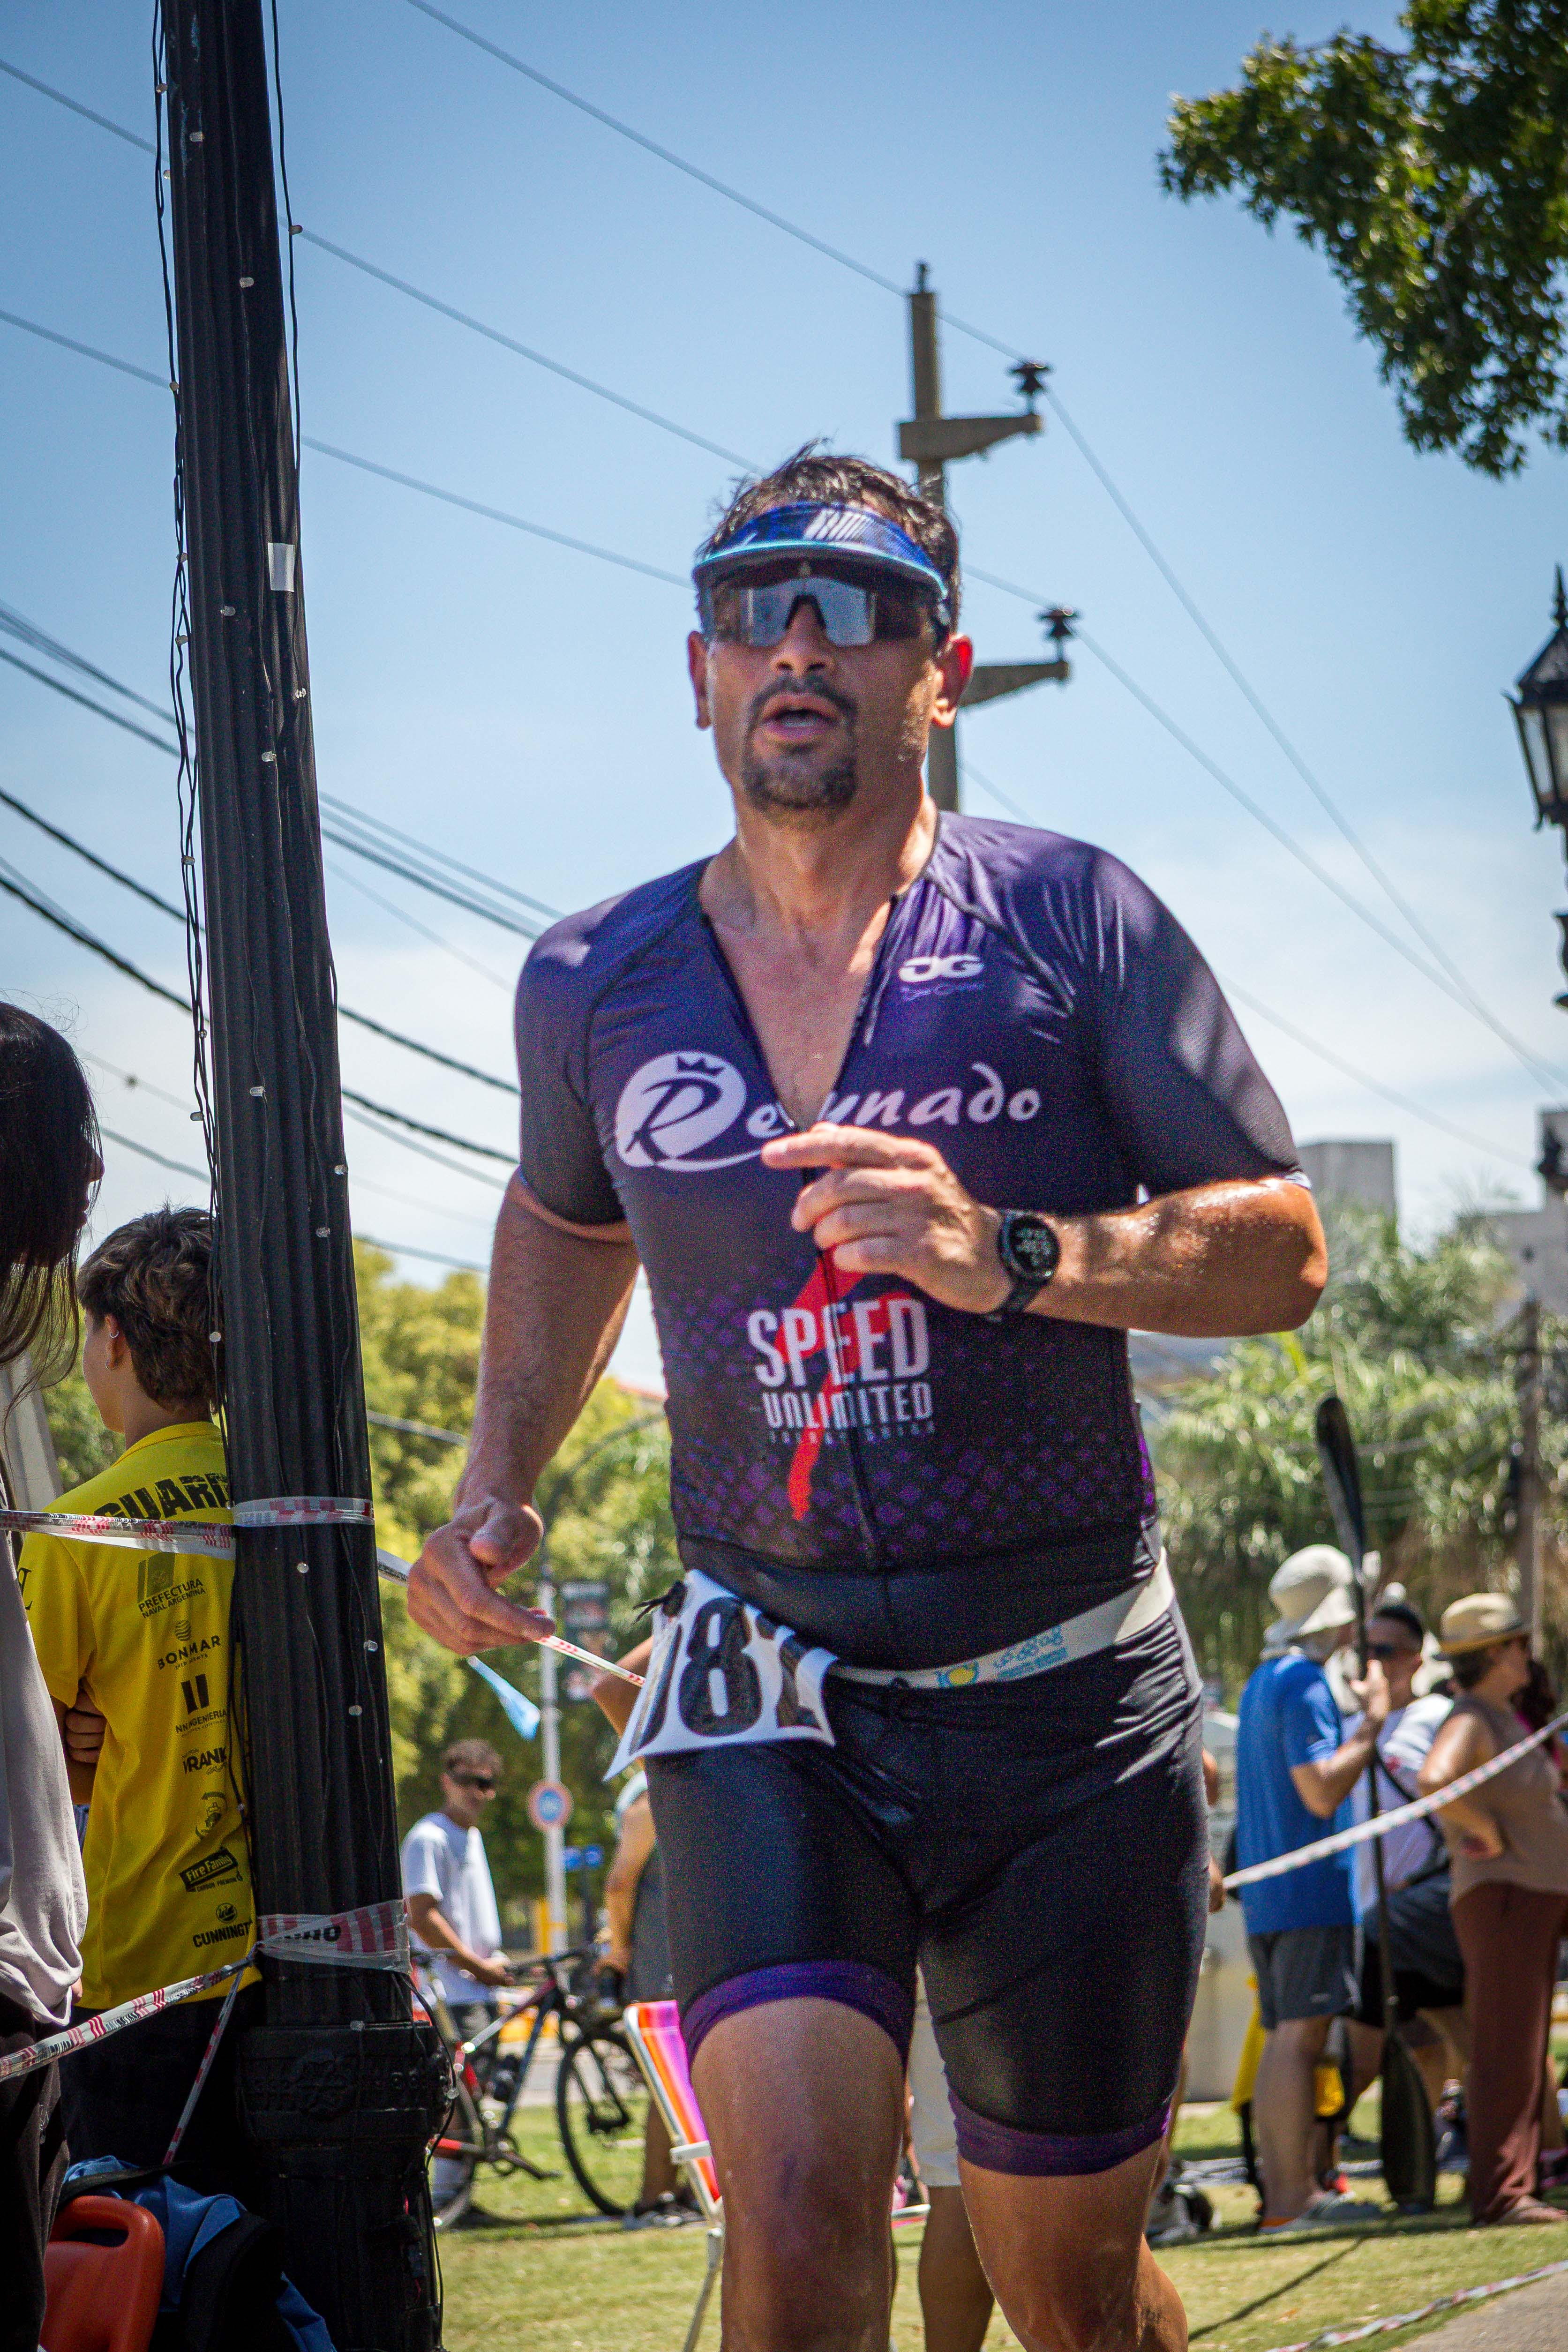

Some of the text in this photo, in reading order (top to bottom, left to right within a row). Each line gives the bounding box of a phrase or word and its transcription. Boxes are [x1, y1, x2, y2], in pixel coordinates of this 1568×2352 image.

[747, 1298, 930, 1387] SPEED
[761, 1381, 934, 1430] UNLIMITED
[138, 1578, 203, 1612] PREFECTURA
[142, 1604, 167, 1618] NAVAL
[158, 1635, 221, 1670] BONMAR
[186, 1866, 206, 1881] Fire
